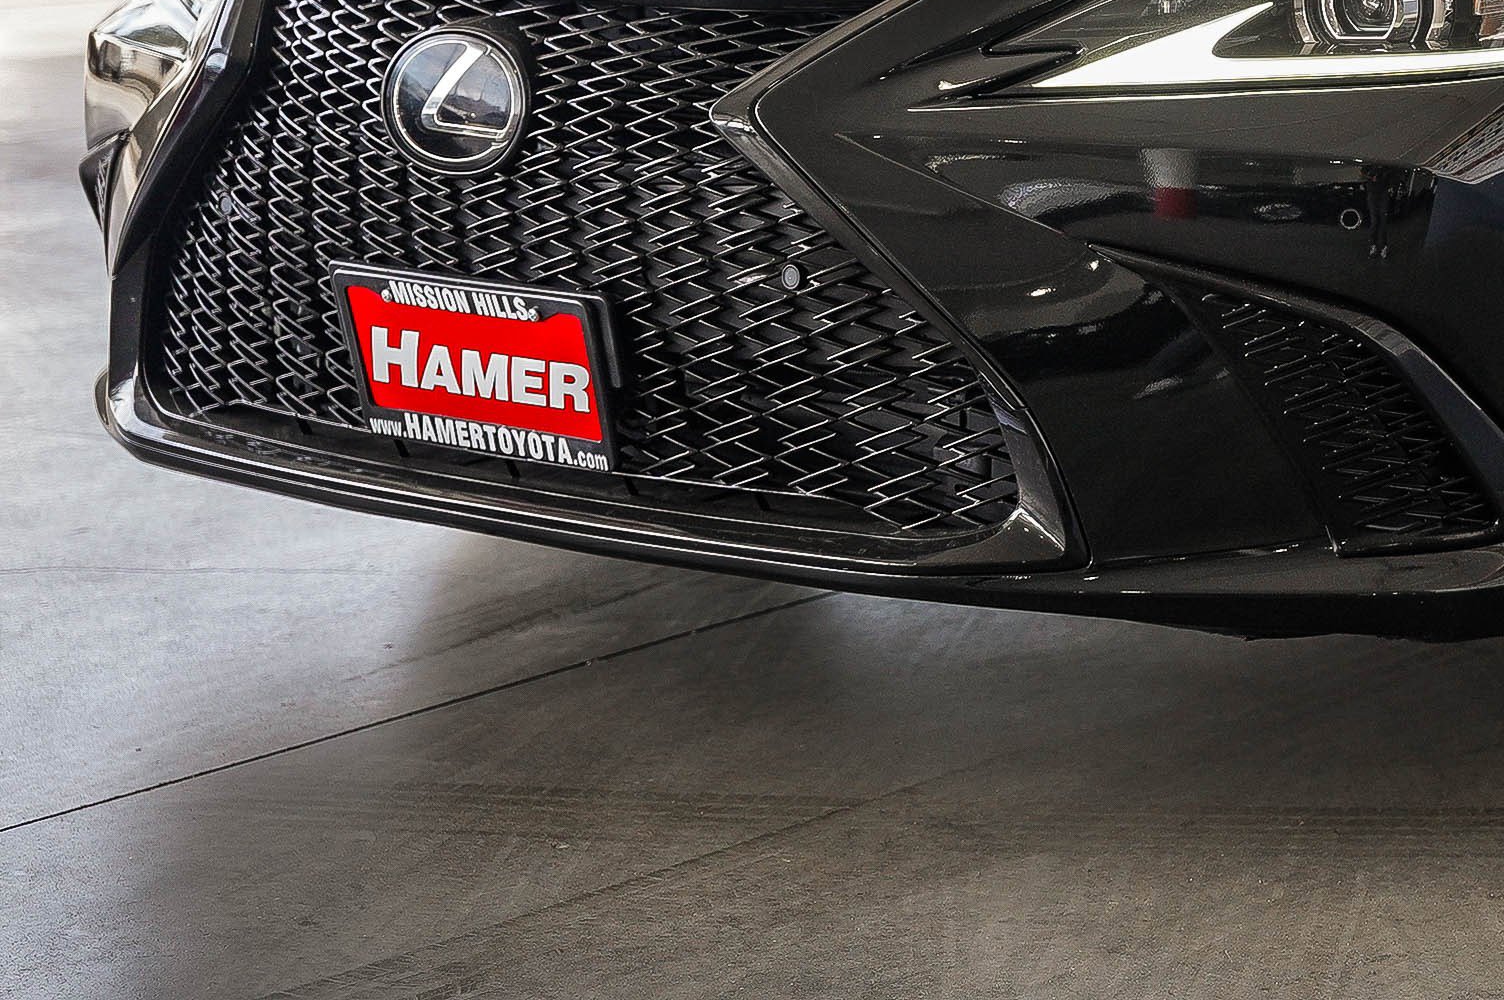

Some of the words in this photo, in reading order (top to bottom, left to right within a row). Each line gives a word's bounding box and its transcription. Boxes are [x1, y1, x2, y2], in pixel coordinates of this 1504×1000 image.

[388, 280, 471, 314] MISSION
[471, 292, 529, 321] HILLS
[370, 325, 591, 414] HAMER
[369, 412, 609, 471] www.HAMERTOYOTA.com
